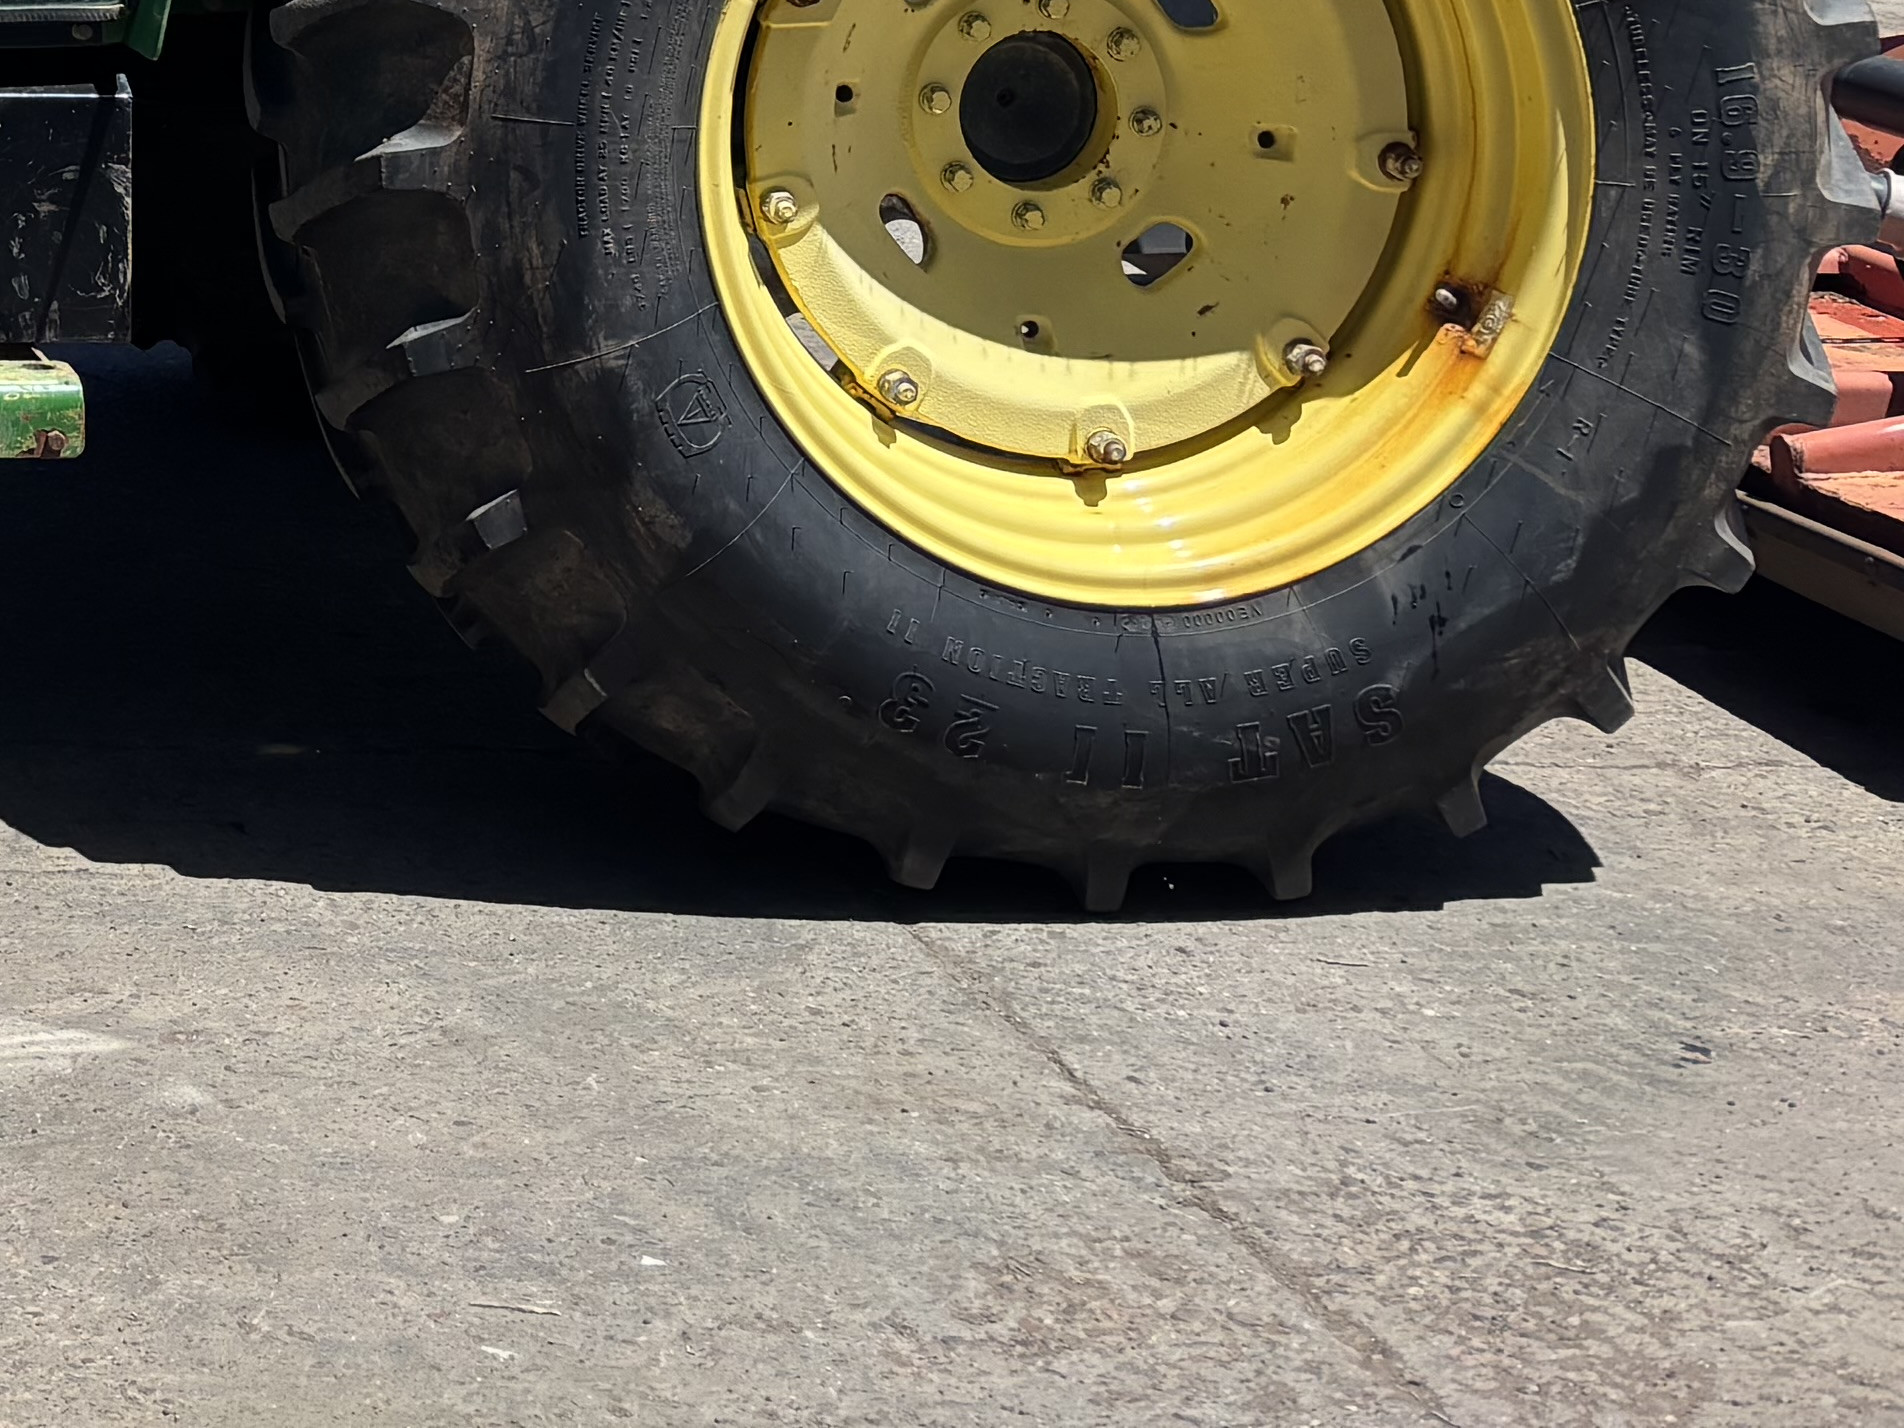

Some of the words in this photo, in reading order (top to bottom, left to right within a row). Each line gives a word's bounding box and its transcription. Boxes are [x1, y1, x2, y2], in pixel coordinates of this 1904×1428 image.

[1688, 107, 1710, 146] ON
[1677, 225, 1705, 277] RIM
[1247, 635, 1374, 699] SUPER
[1063, 723, 1150, 790] II
[1226, 682, 1406, 784] SAT
